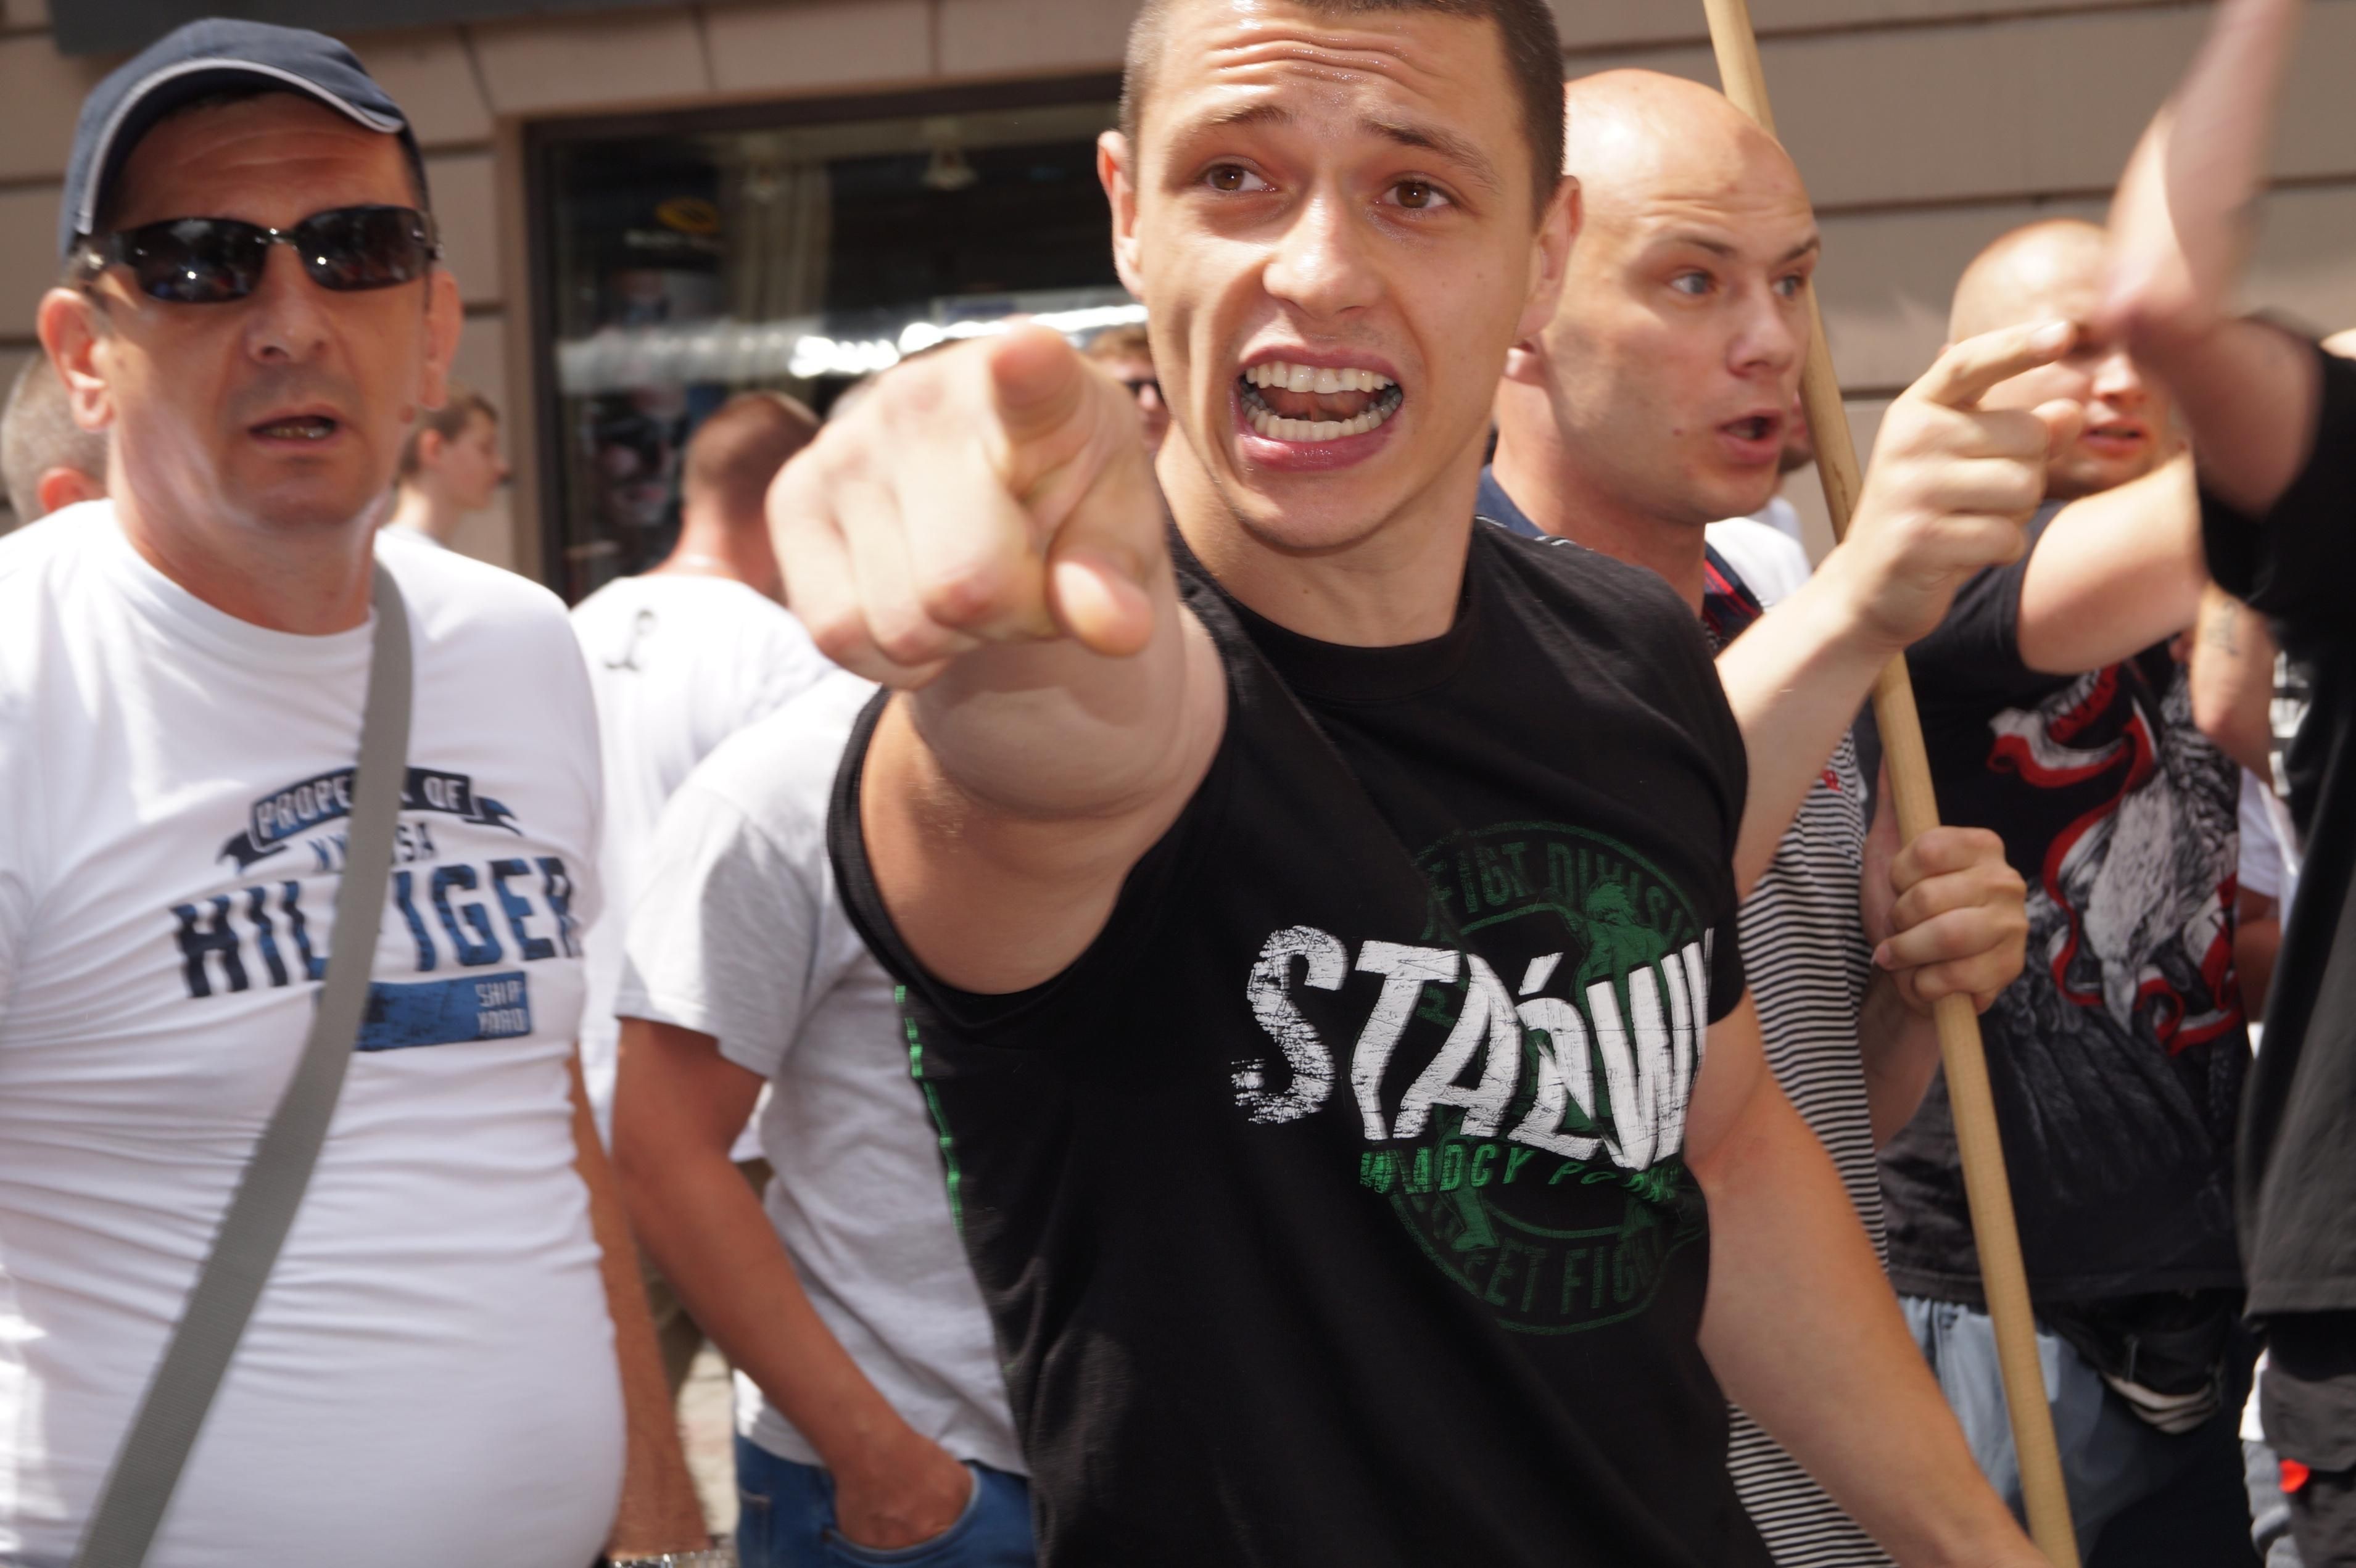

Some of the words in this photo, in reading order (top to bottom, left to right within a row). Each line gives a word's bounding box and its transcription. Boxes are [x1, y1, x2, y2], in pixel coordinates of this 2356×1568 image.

[255, 774, 410, 839] PROPE
[422, 776, 466, 811] OF
[170, 857, 582, 998] HILIGER
